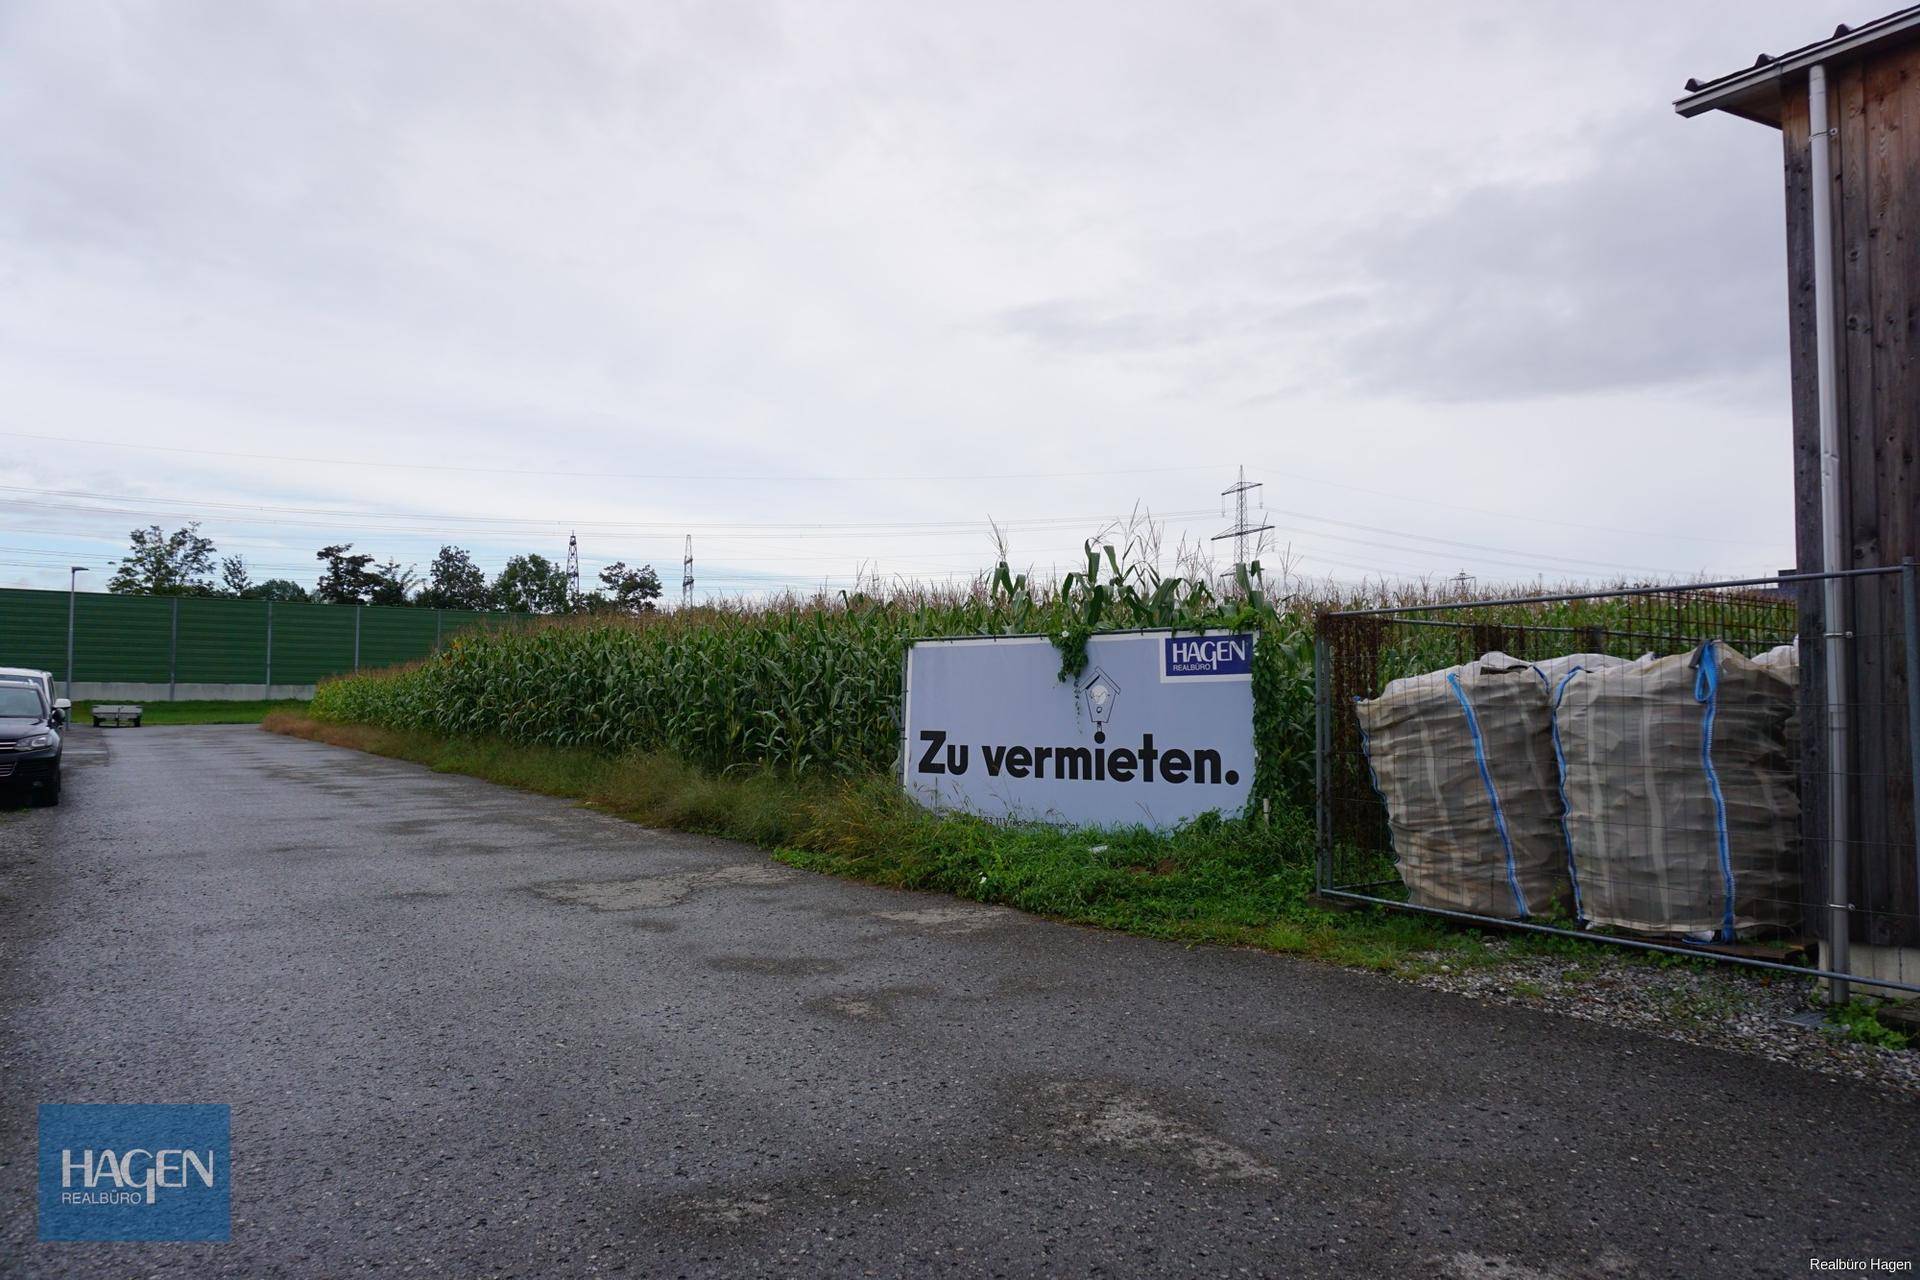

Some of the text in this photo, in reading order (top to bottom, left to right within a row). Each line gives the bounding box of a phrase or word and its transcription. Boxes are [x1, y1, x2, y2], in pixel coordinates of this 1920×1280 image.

[1172, 639, 1246, 670] HAGEN
[1173, 662, 1211, 672] REALBÜRO
[918, 730, 1239, 785] Zu vermieten.
